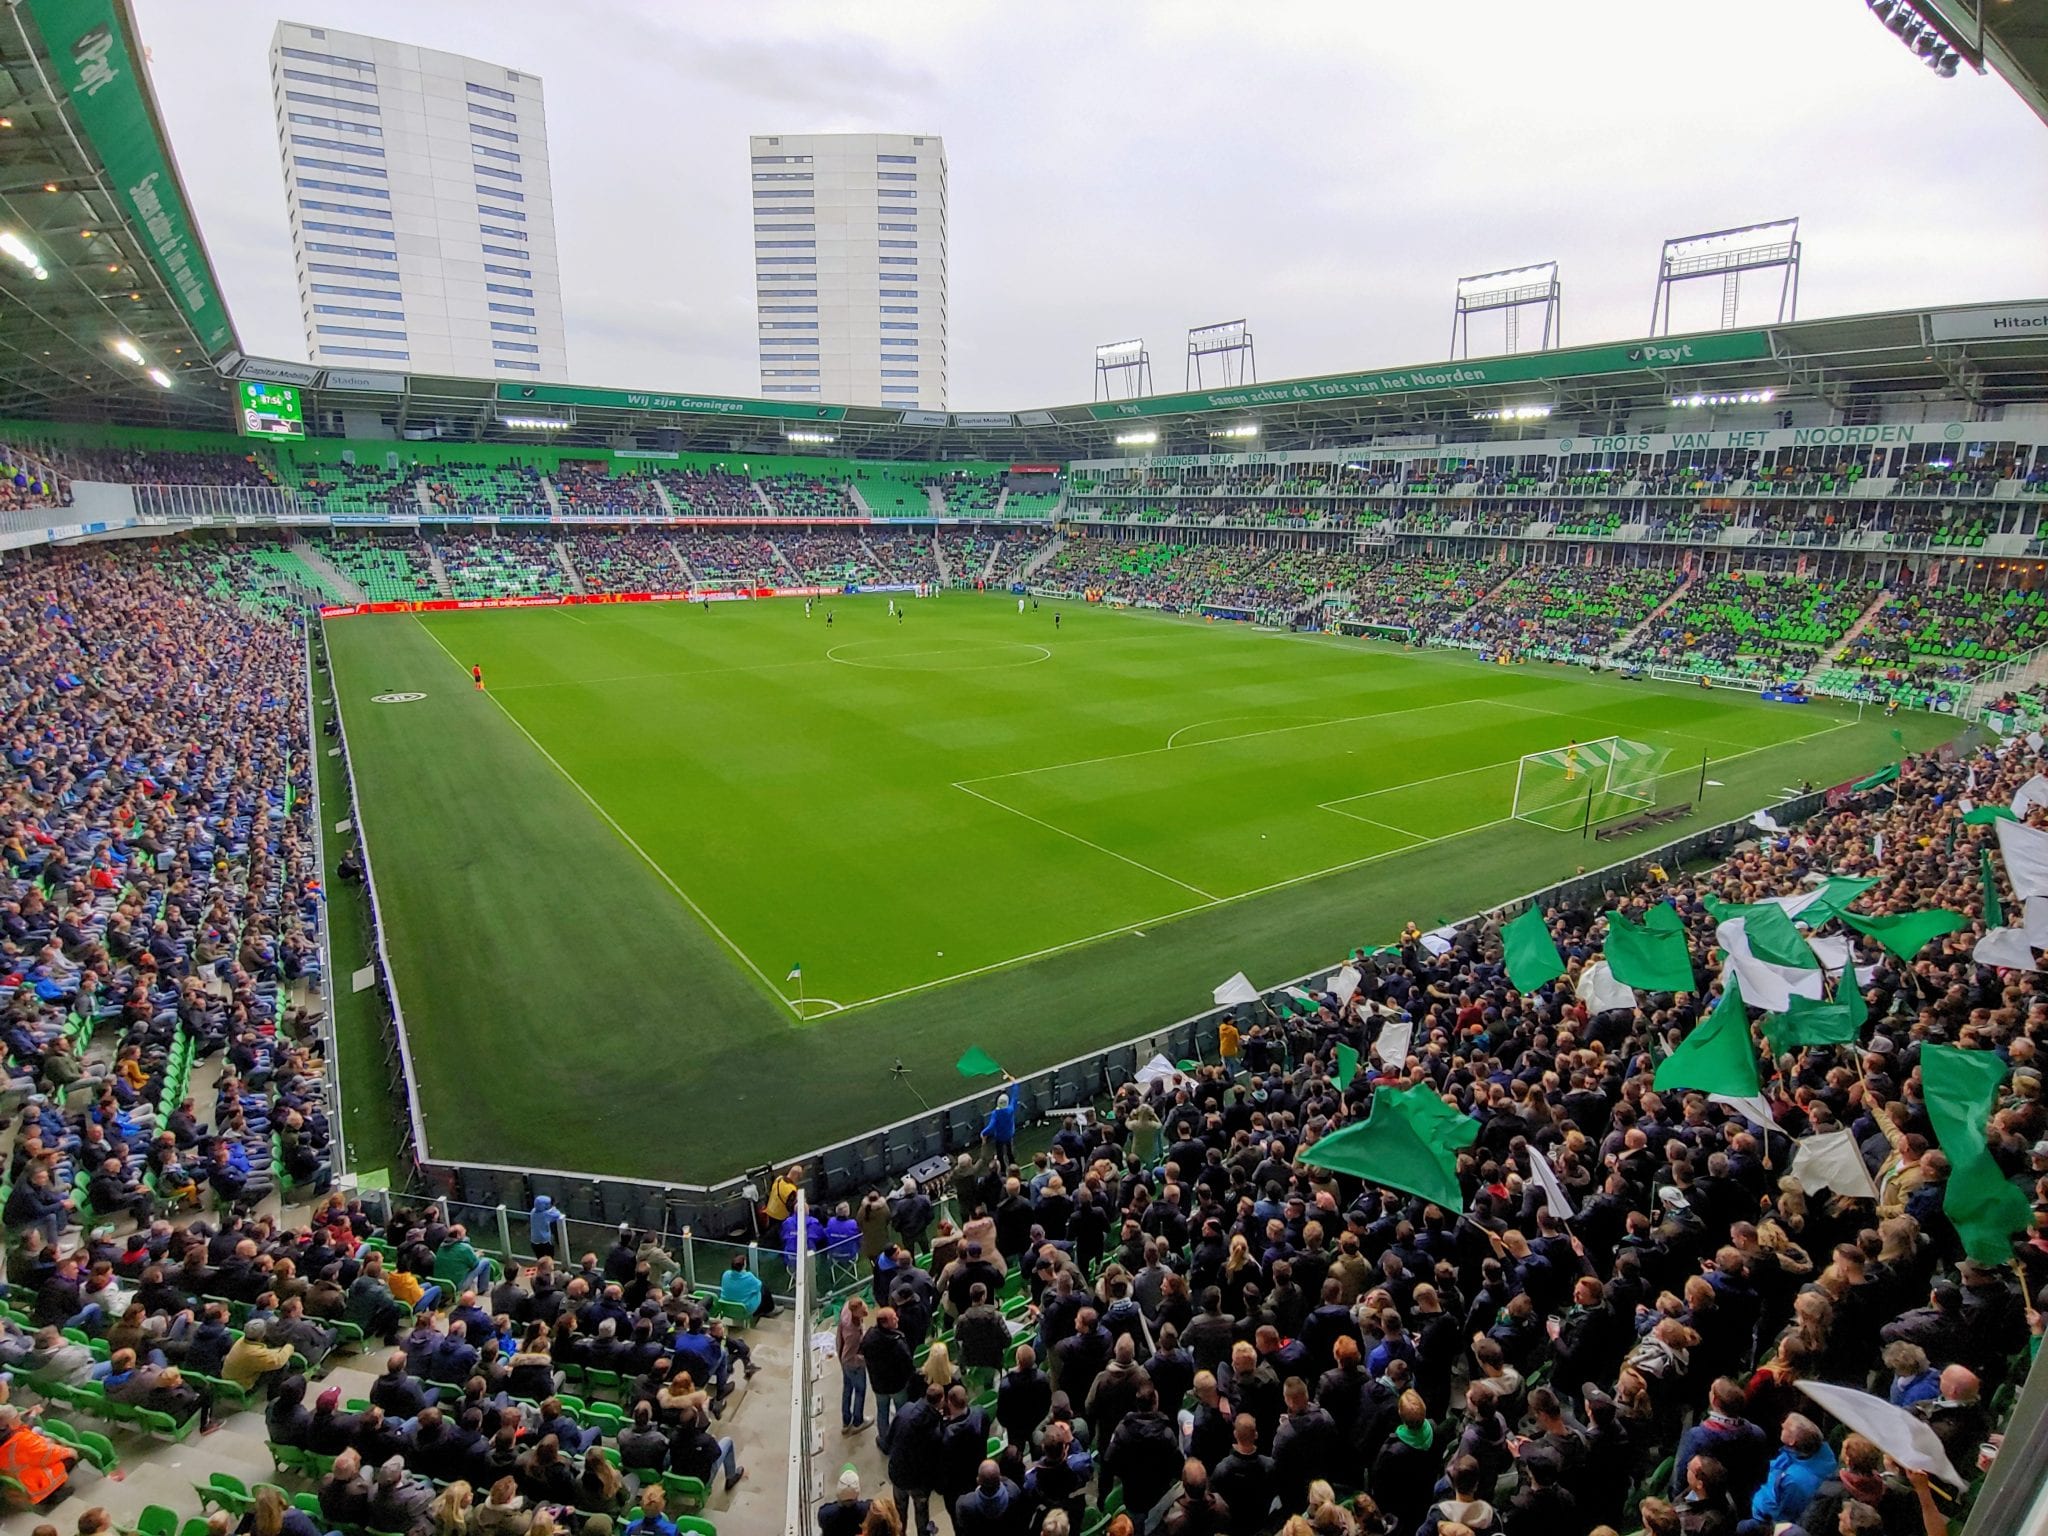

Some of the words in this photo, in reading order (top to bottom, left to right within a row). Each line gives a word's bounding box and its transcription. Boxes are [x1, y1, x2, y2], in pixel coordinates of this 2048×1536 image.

[1643, 343, 1695, 363] Payt
[245, 365, 278, 376] Capital
[279, 369, 311, 381] Mobility
[332, 376, 370, 385] Stadion
[1209, 394, 1248, 406] Samen
[1250, 389, 1289, 401] achter
[1292, 385, 1309, 398] de
[1311, 383, 1348, 396] Trots
[1351, 380, 1379, 392] van
[1383, 377, 1408, 390] het
[1411, 368, 1486, 386] Noorden
[627, 394, 650, 407] Wij
[653, 397, 677, 408] zijn
[681, 398, 744, 411] Groningen
[1121, 403, 1141, 415] Payt
[958, 417, 982, 425] Capital
[982, 417, 1010, 425] Mobility
[1592, 435, 1650, 452] TROTS
[1672, 433, 1711, 449] VAN
[1727, 431, 1770, 447] HET
[1794, 425, 1915, 446] NOORDEN
[1138, 457, 1148, 467] FC
[1150, 455, 1199, 467] GRONINGEN
[1248, 452, 1268, 463] 1971
[1347, 451, 1371, 460] KNVB
[1446, 447, 1468, 457] 2015
